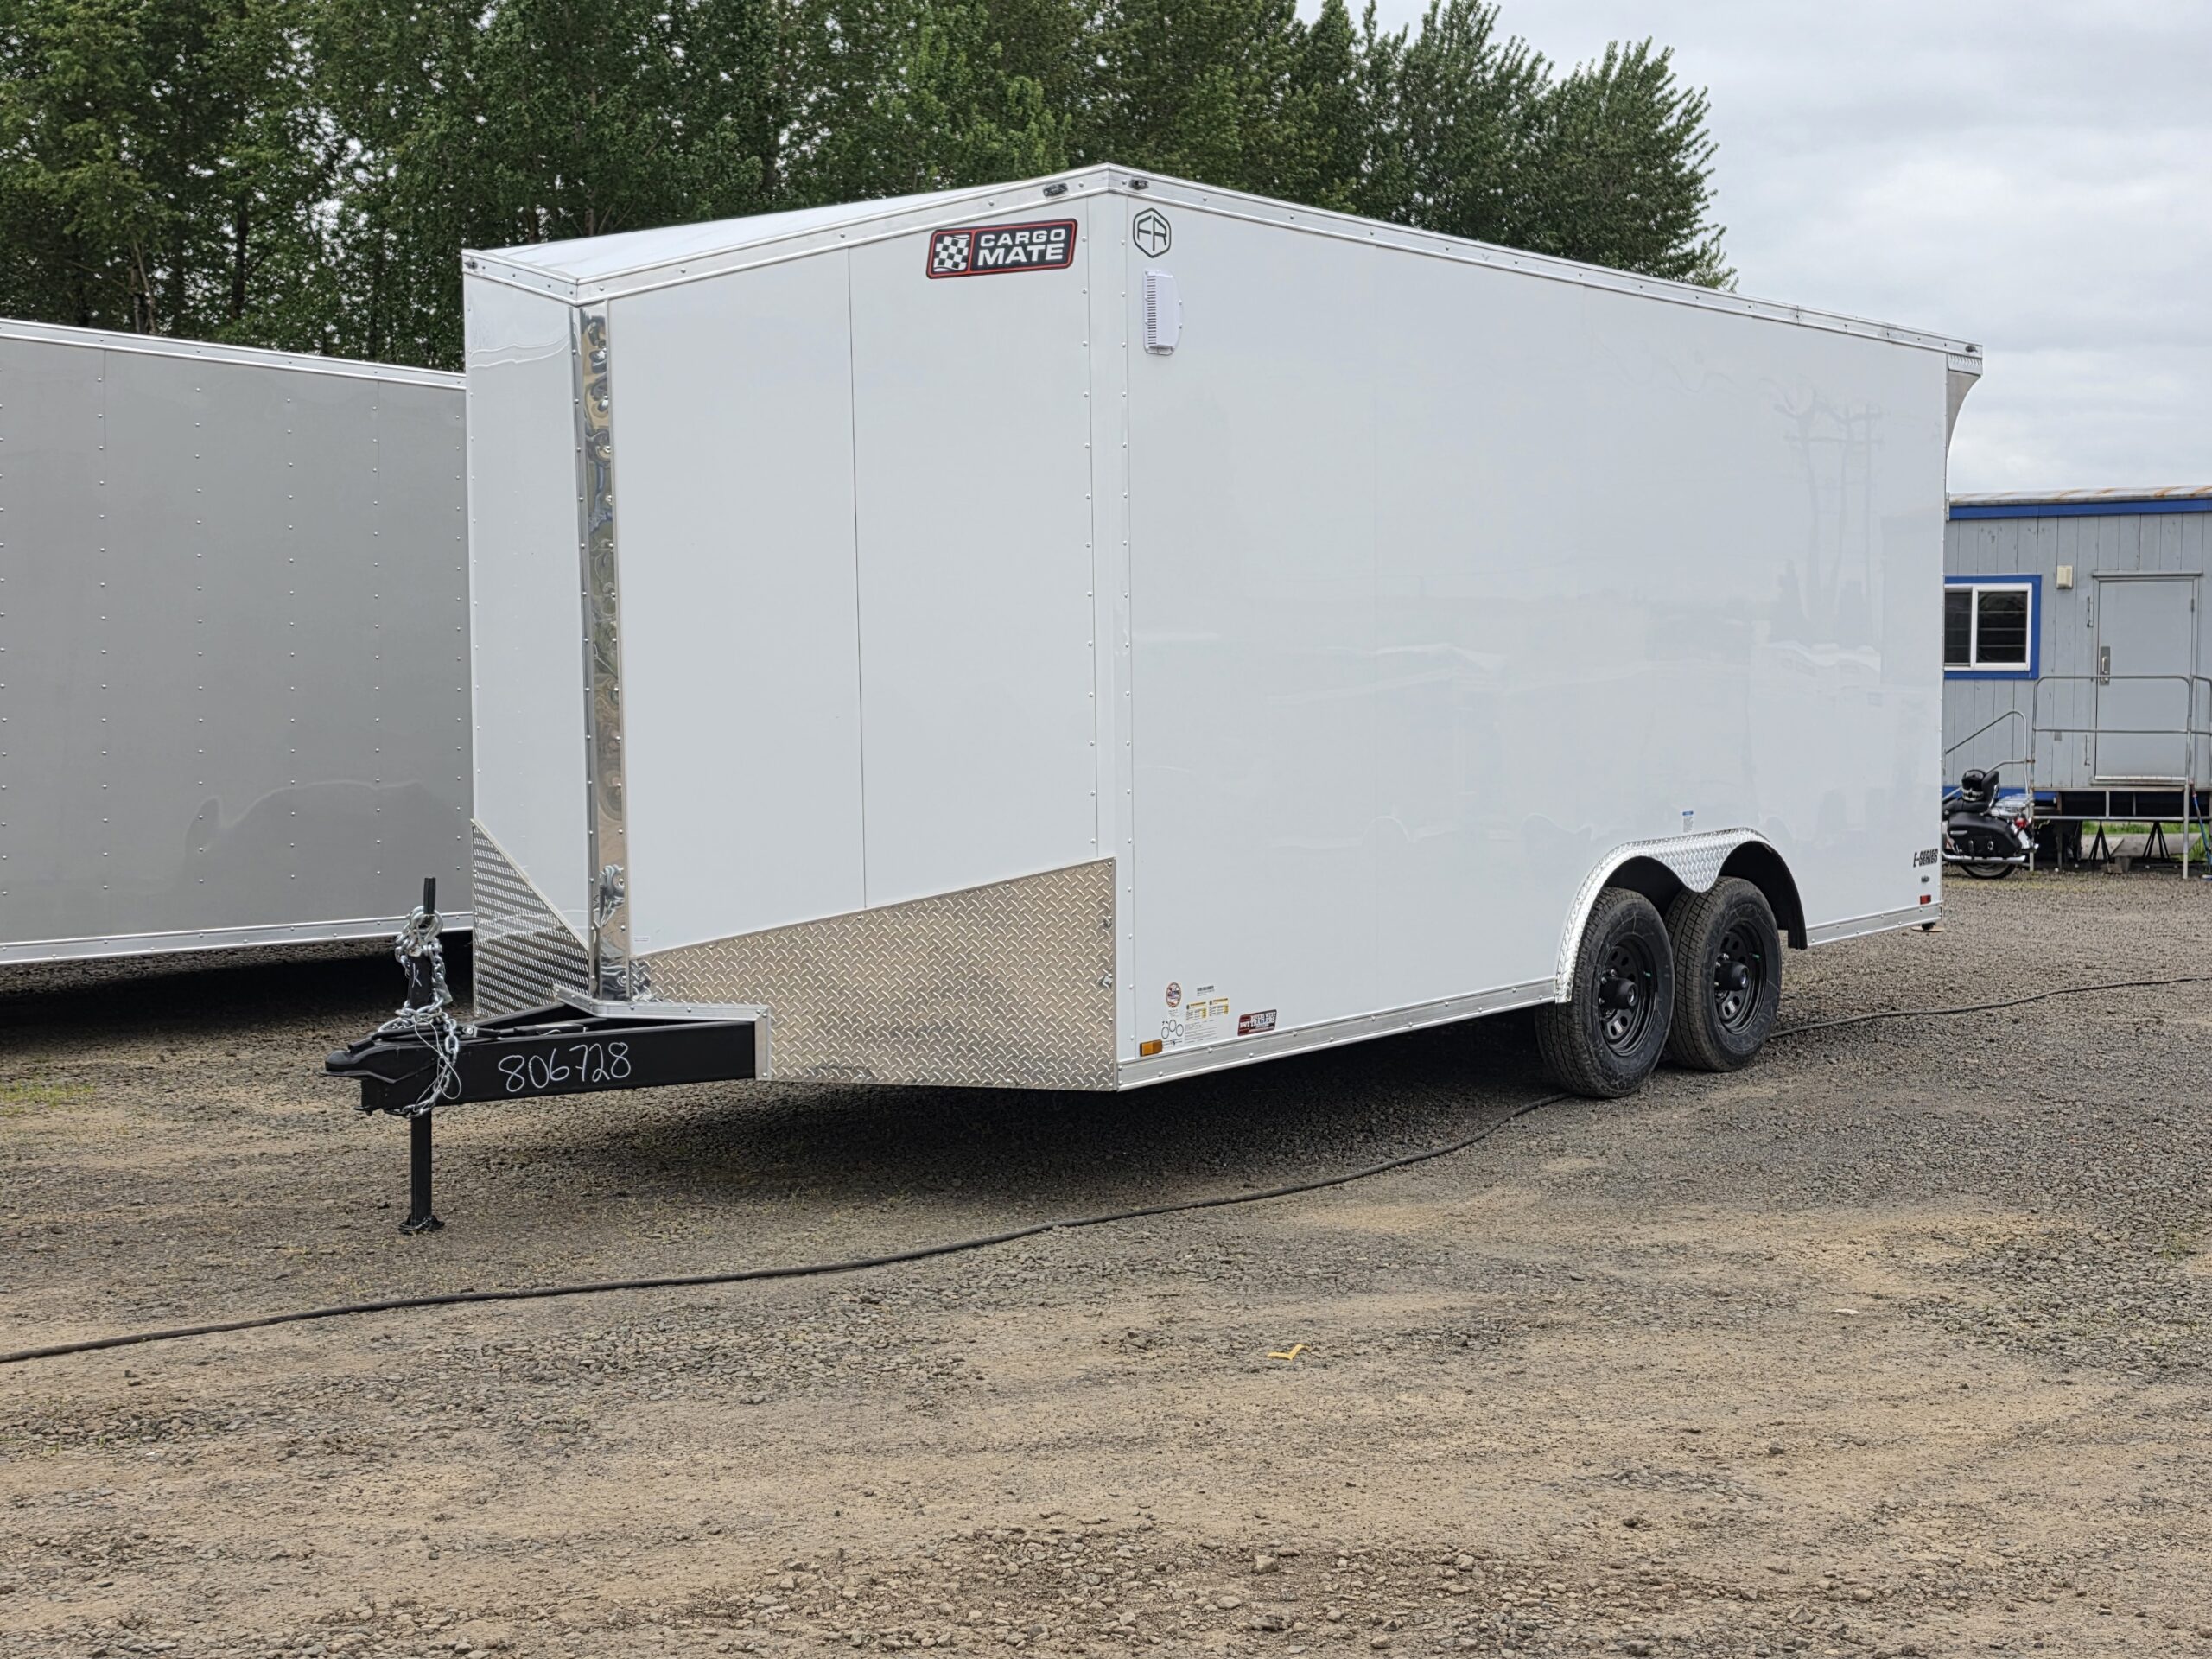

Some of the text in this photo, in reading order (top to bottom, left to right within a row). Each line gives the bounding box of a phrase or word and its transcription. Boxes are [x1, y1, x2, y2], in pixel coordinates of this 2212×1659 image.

[980, 228, 1066, 247] CARGO
[977, 243, 1065, 266] MATE
[1913, 848, 1939, 868] E-SERIES
[498, 1041, 632, 1093] 806728
